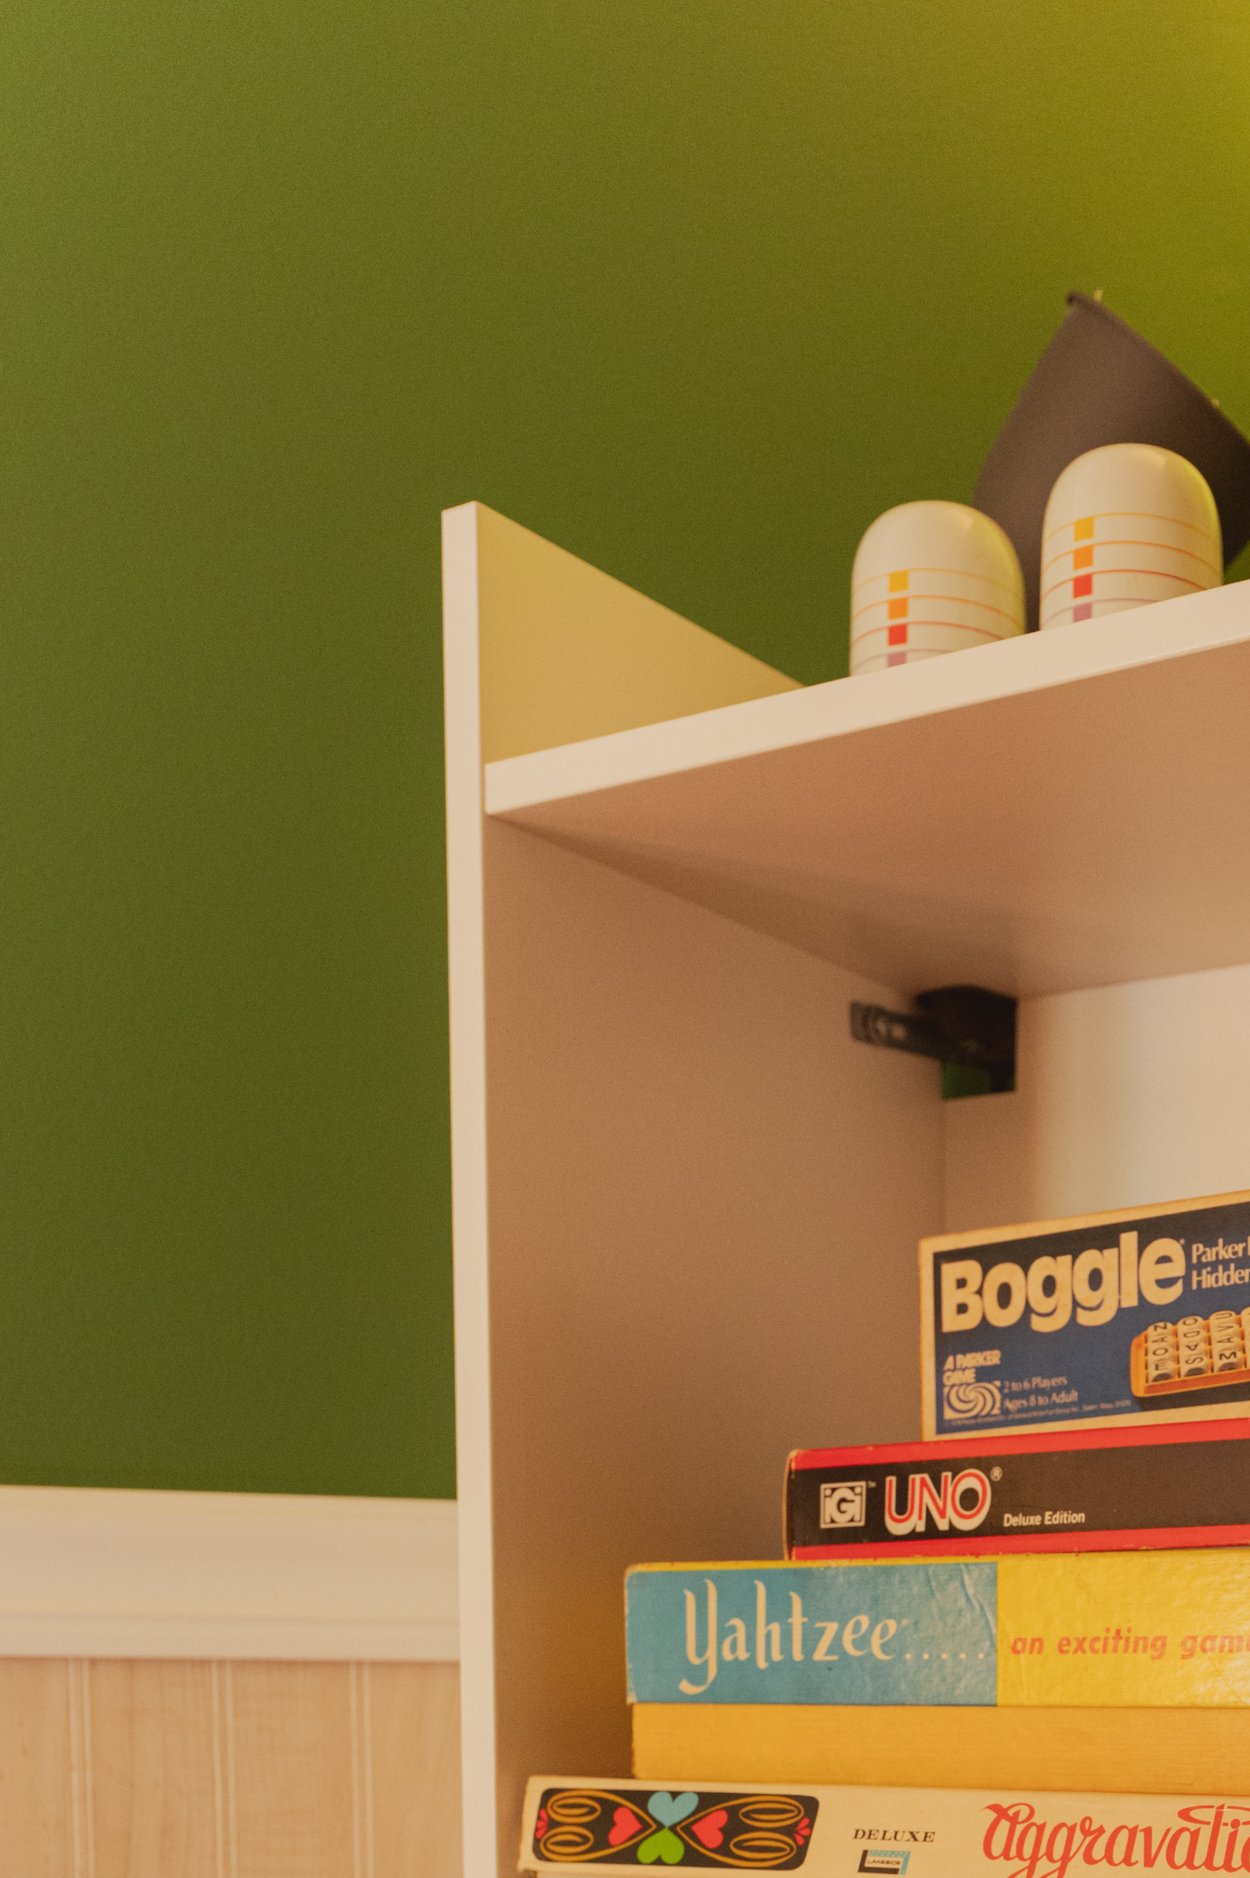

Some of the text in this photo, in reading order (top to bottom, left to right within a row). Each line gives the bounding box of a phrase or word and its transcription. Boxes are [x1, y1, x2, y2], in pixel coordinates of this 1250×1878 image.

[1191, 1237, 1246, 1264] Parker
[941, 1231, 1187, 1333] Boggle
[1031, 1376, 1068, 1391] Players
[1004, 1399, 1028, 1414] Ages
[1050, 1389, 1079, 1404] Adult
[1003, 1510, 1086, 1528] Deluxe Edition
[1010, 1635, 1045, 1656] an
[1057, 1627, 1168, 1660] exciting
[853, 1828, 936, 1842] DELUXE
